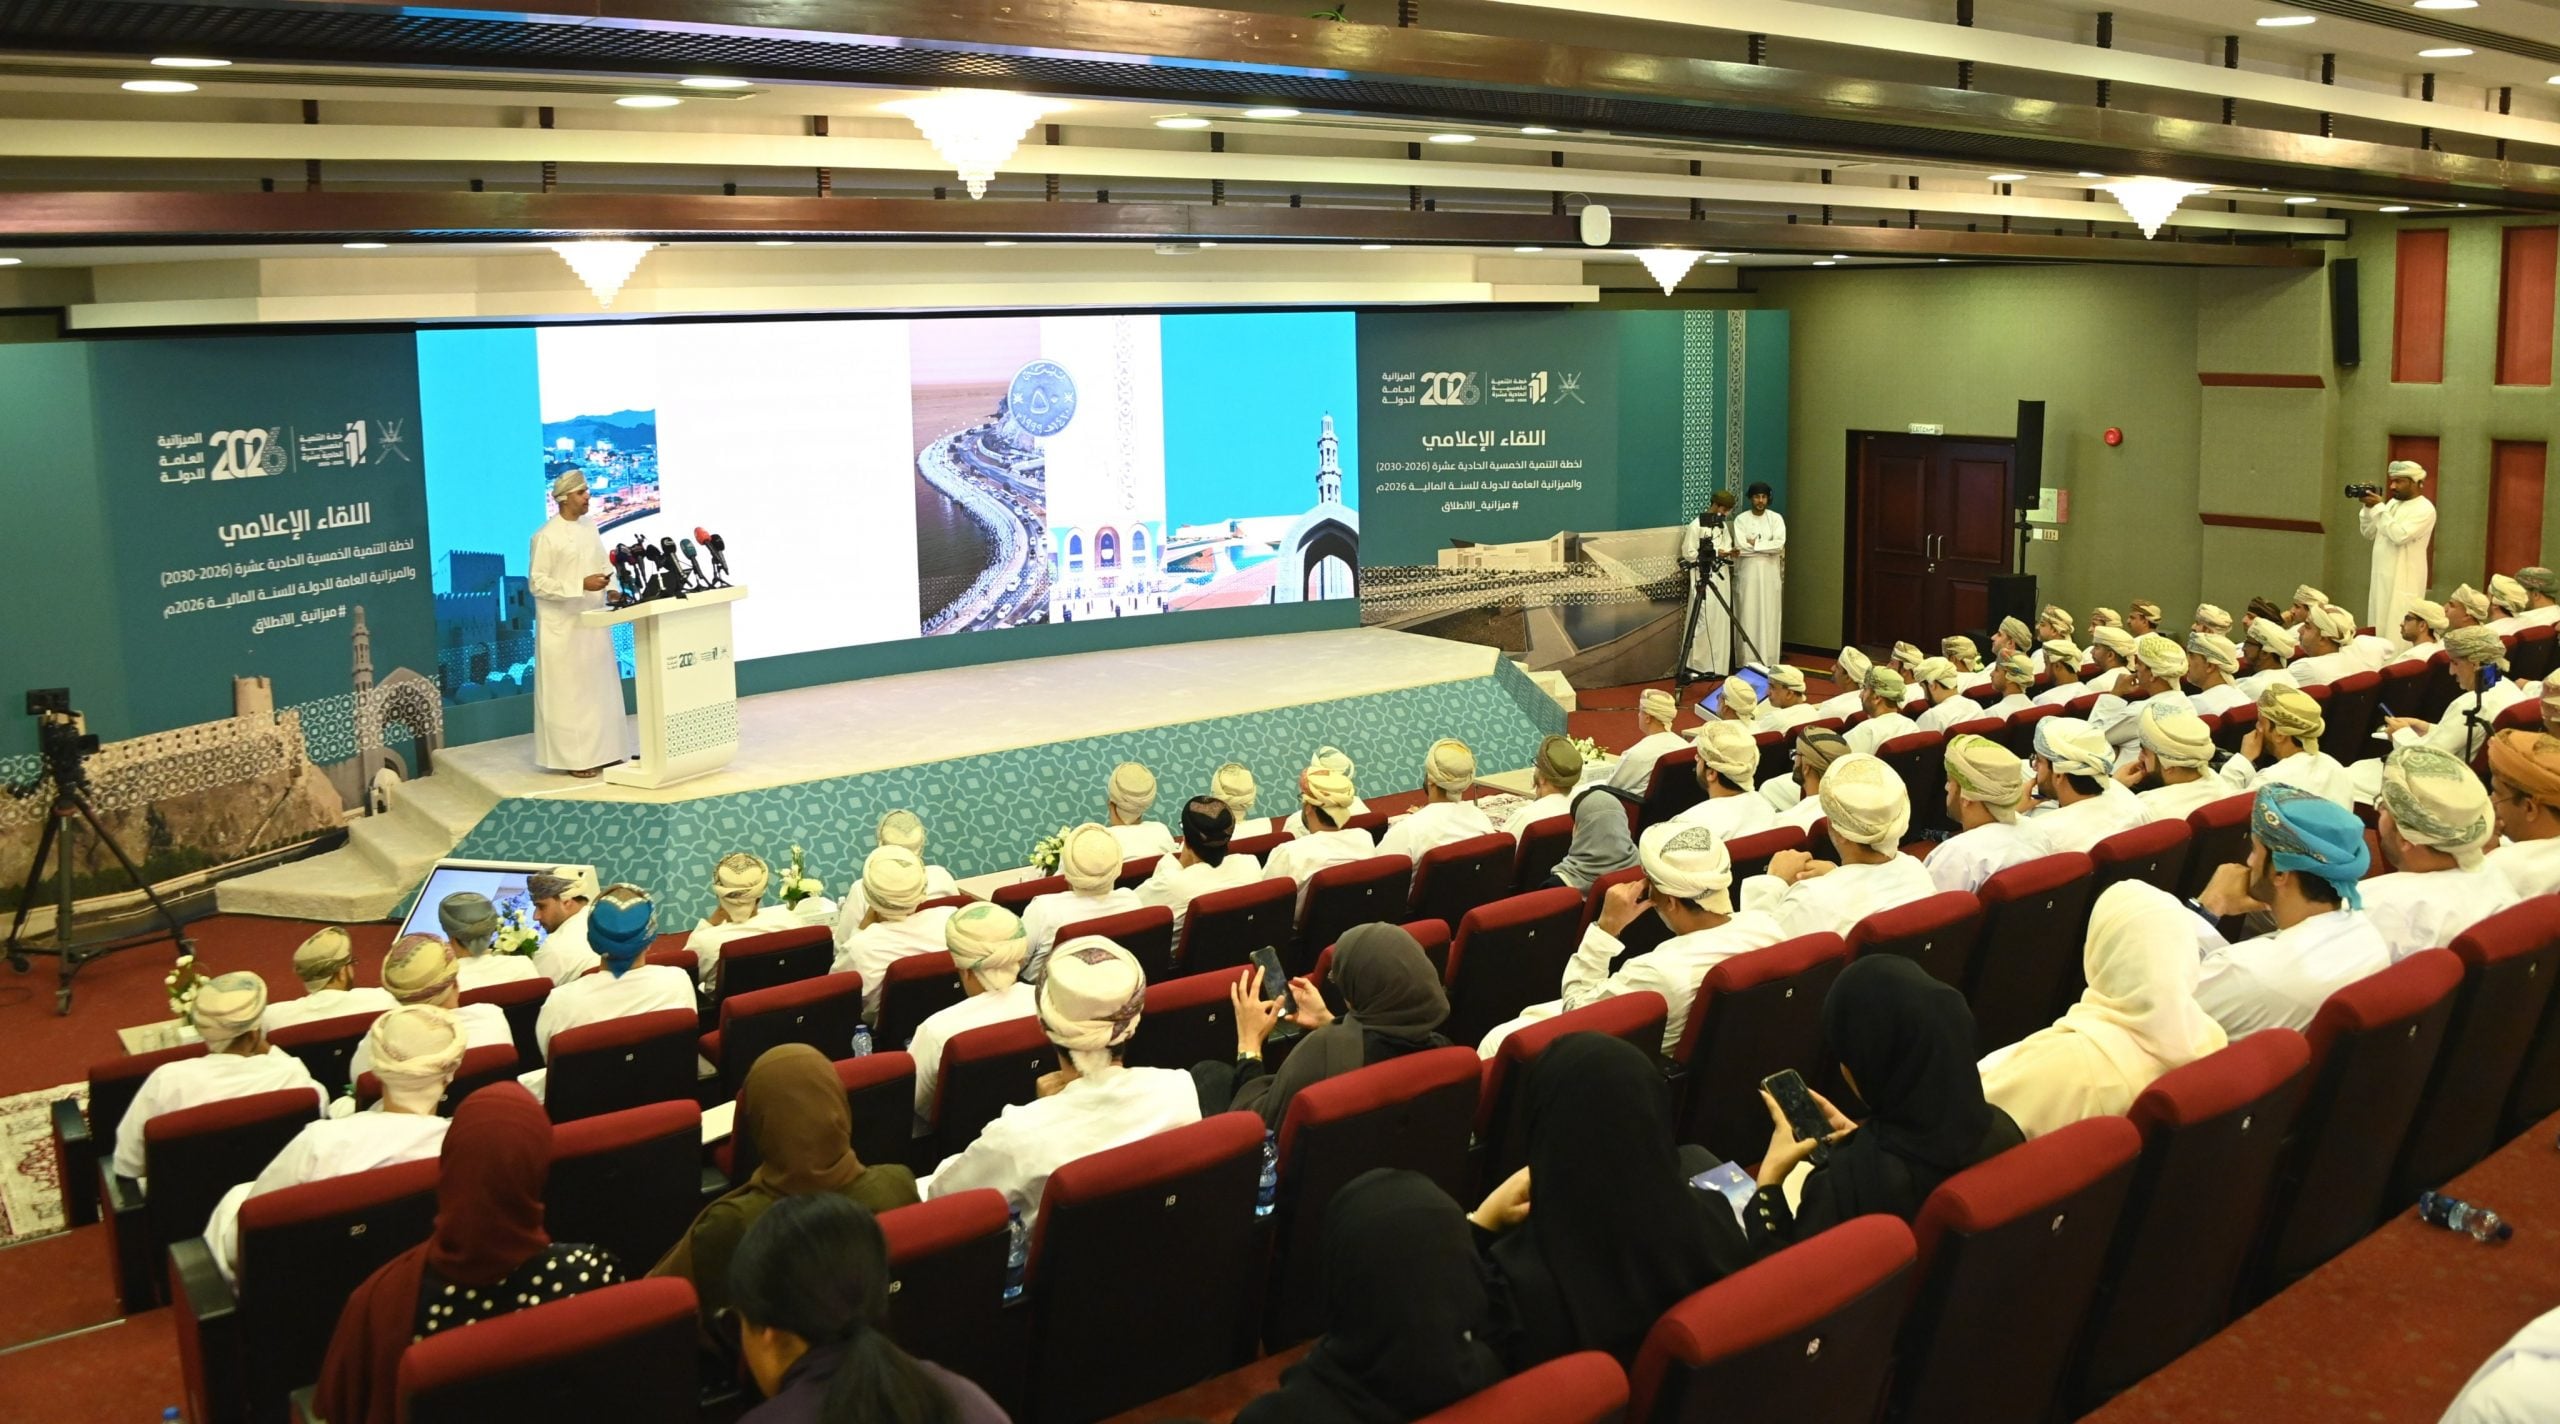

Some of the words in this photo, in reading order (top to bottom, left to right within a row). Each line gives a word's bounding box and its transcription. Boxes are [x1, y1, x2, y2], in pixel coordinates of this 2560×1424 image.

[1382, 372, 1415, 382] الميزانية
[1420, 372, 1480, 406] 2026
[1030, 390, 1058, 414] ٥٠
[1382, 396, 1415, 406] للدولة
[158, 432, 203, 449] الميزانية
[1422, 430, 1494, 452] الإعلامي
[1500, 430, 1546, 446] اللقاء
[159, 452, 204, 466] العامة
[209, 426, 287, 480] 2026
[1432, 461, 1456, 472] عشرة
[1458, 461, 1488, 472] الحادية
[1489, 460, 1527, 470] الخمسية
[1528, 460, 1558, 470] التنمية
[1560, 460, 1582, 468] لخطة
[160, 468, 206, 484] للدولة
[1408, 482, 1446, 491] المالية
[1448, 481, 1479, 490] للسنة
[1481, 481, 1510, 492] للدولة
[1511, 480, 1539, 489] العامة
[1541, 480, 1582, 491] والميزانية
[317, 502, 370, 530] اللقاء
[218, 509, 311, 547] الإعلامي
[353, 542, 387, 559] التنمية
[389, 539, 414, 552] لخطة
[306, 547, 351, 564] الخمسية
[234, 562, 265, 578] عشرة
[267, 554, 305, 572] الحادية
[335, 572, 368, 588] العامة
[369, 566, 416, 584] والميزانية
[257, 584, 296, 600] للسنة
[298, 578, 334, 596] للدولة
[206, 590, 256, 608] المالية
[796, 1016, 804, 1024] 17
[1031, 1060, 1040, 1069] 17
[1165, 1194, 1176, 1206] 18
[350, 1224, 367, 1236] 20
[889, 1280, 901, 1293] 19
